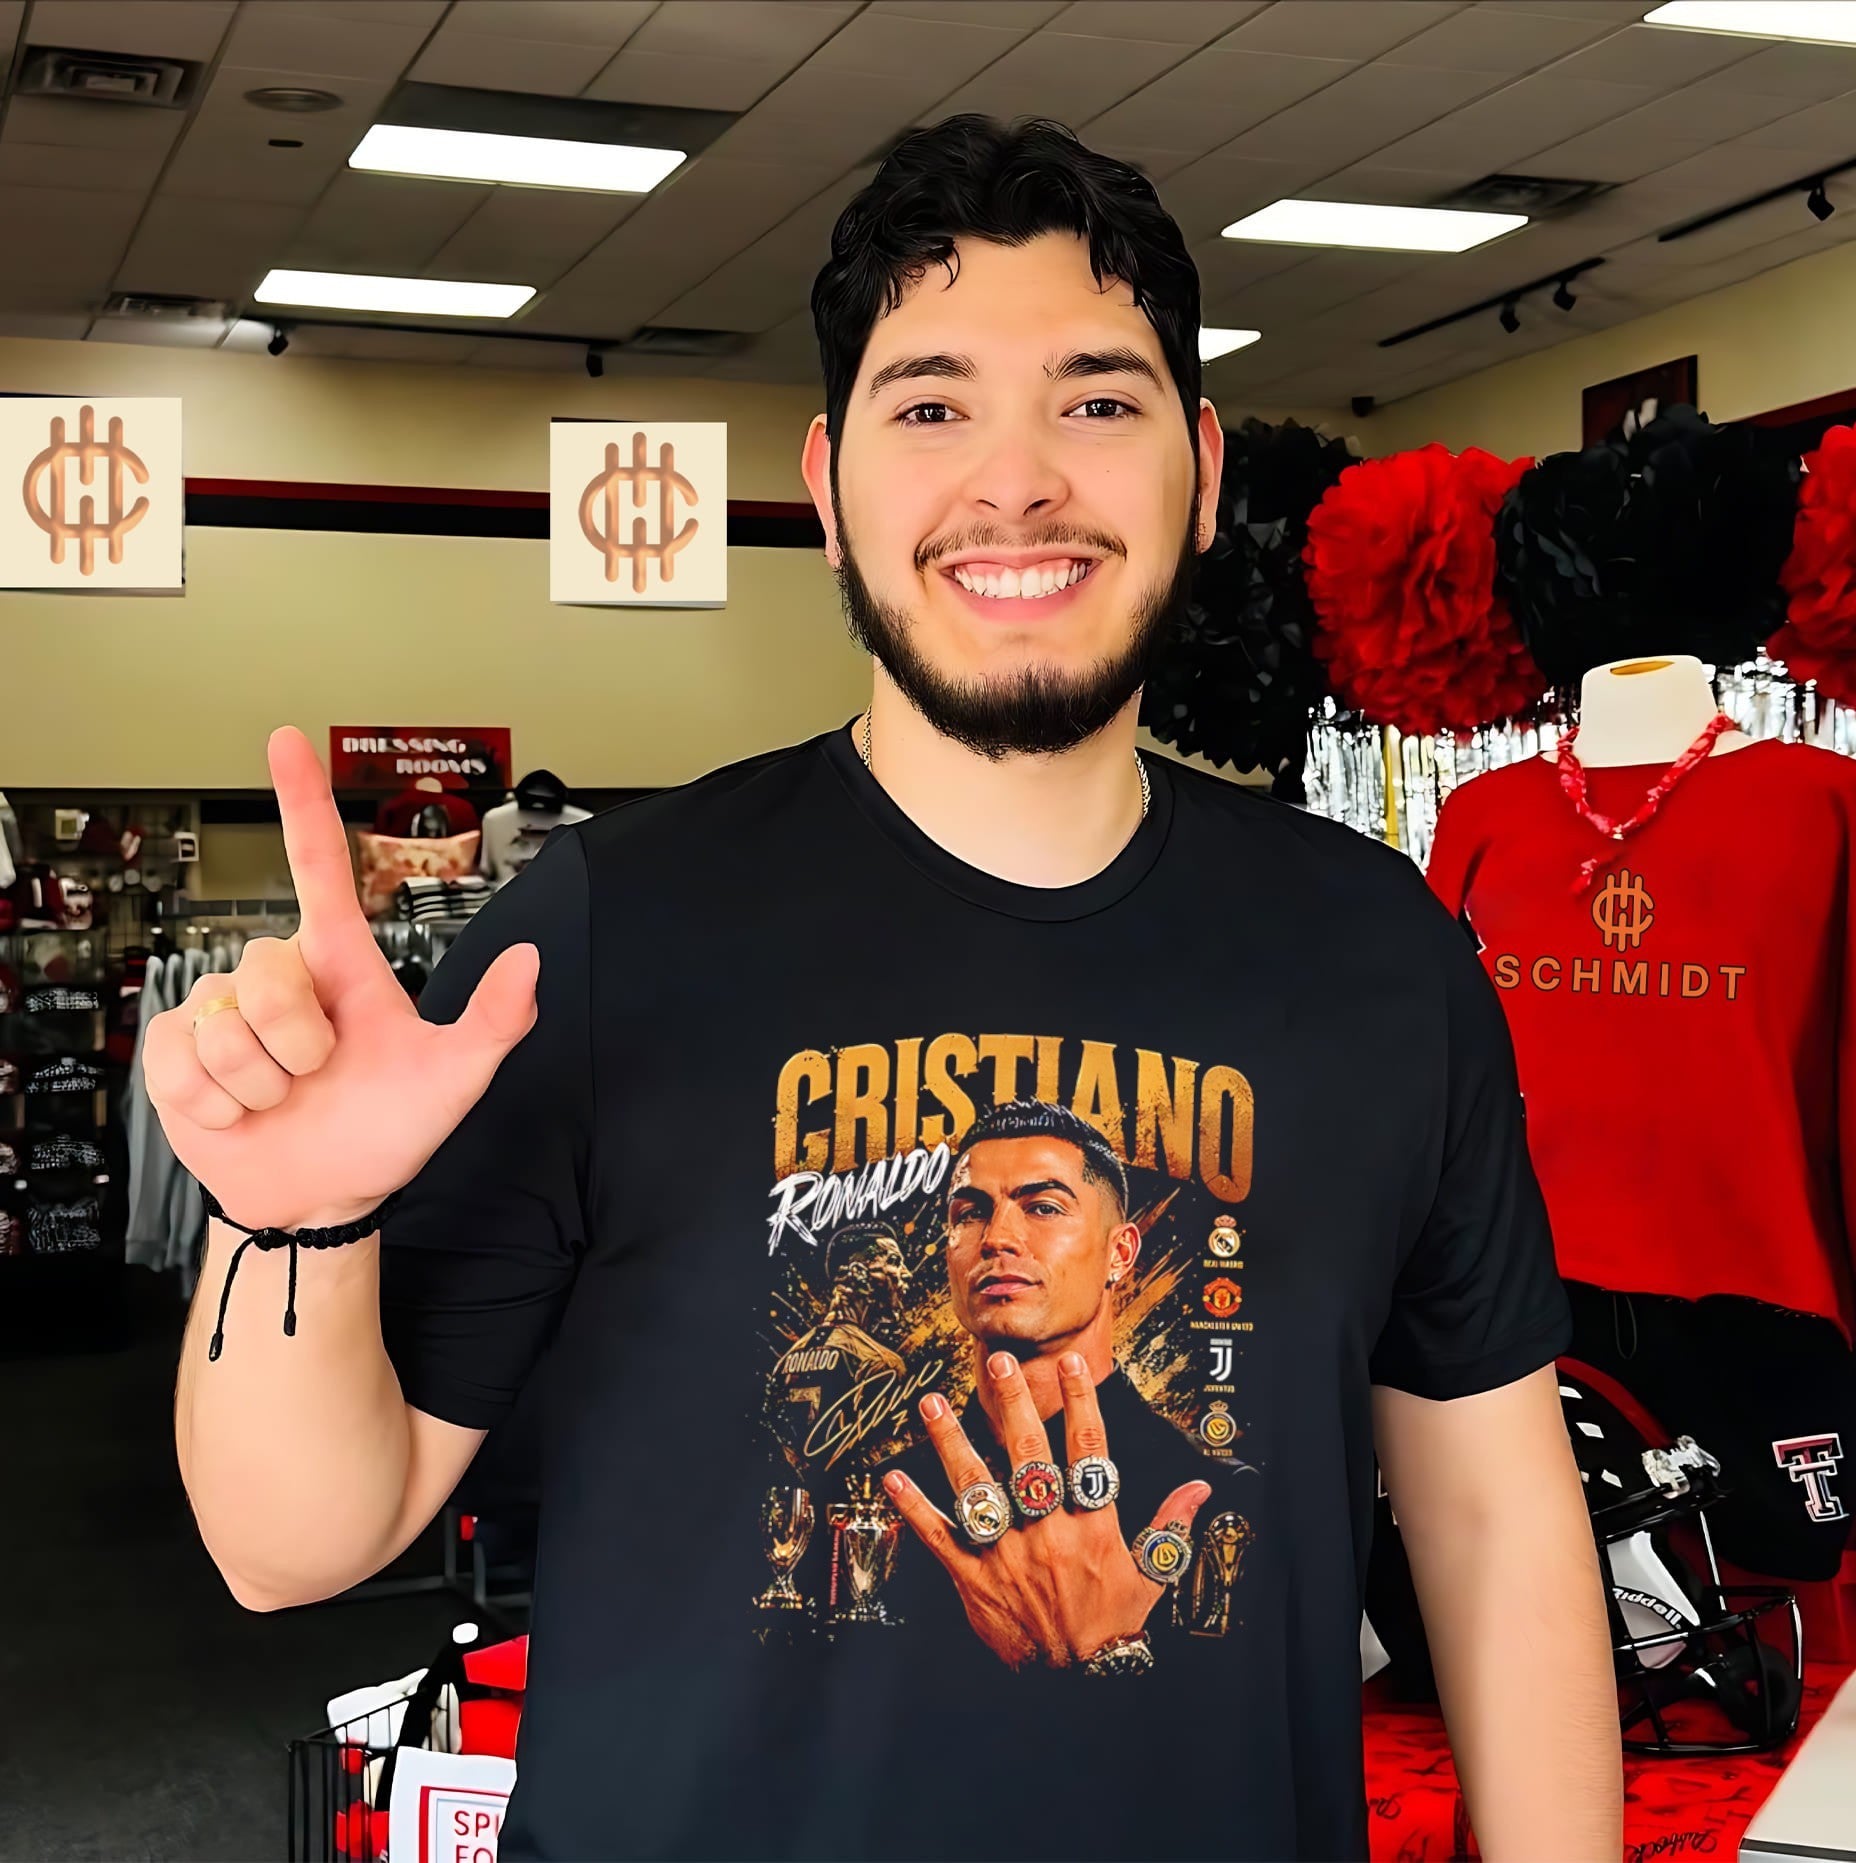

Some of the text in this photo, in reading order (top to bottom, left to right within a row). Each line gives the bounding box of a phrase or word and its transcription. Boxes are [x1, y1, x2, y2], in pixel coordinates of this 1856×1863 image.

[396, 759, 487, 775] ROOMS
[1494, 954, 1747, 1000] SCHMIDT
[773, 1032, 1255, 1204] CRISTIANO
[767, 1142, 953, 1257] RONALDO
